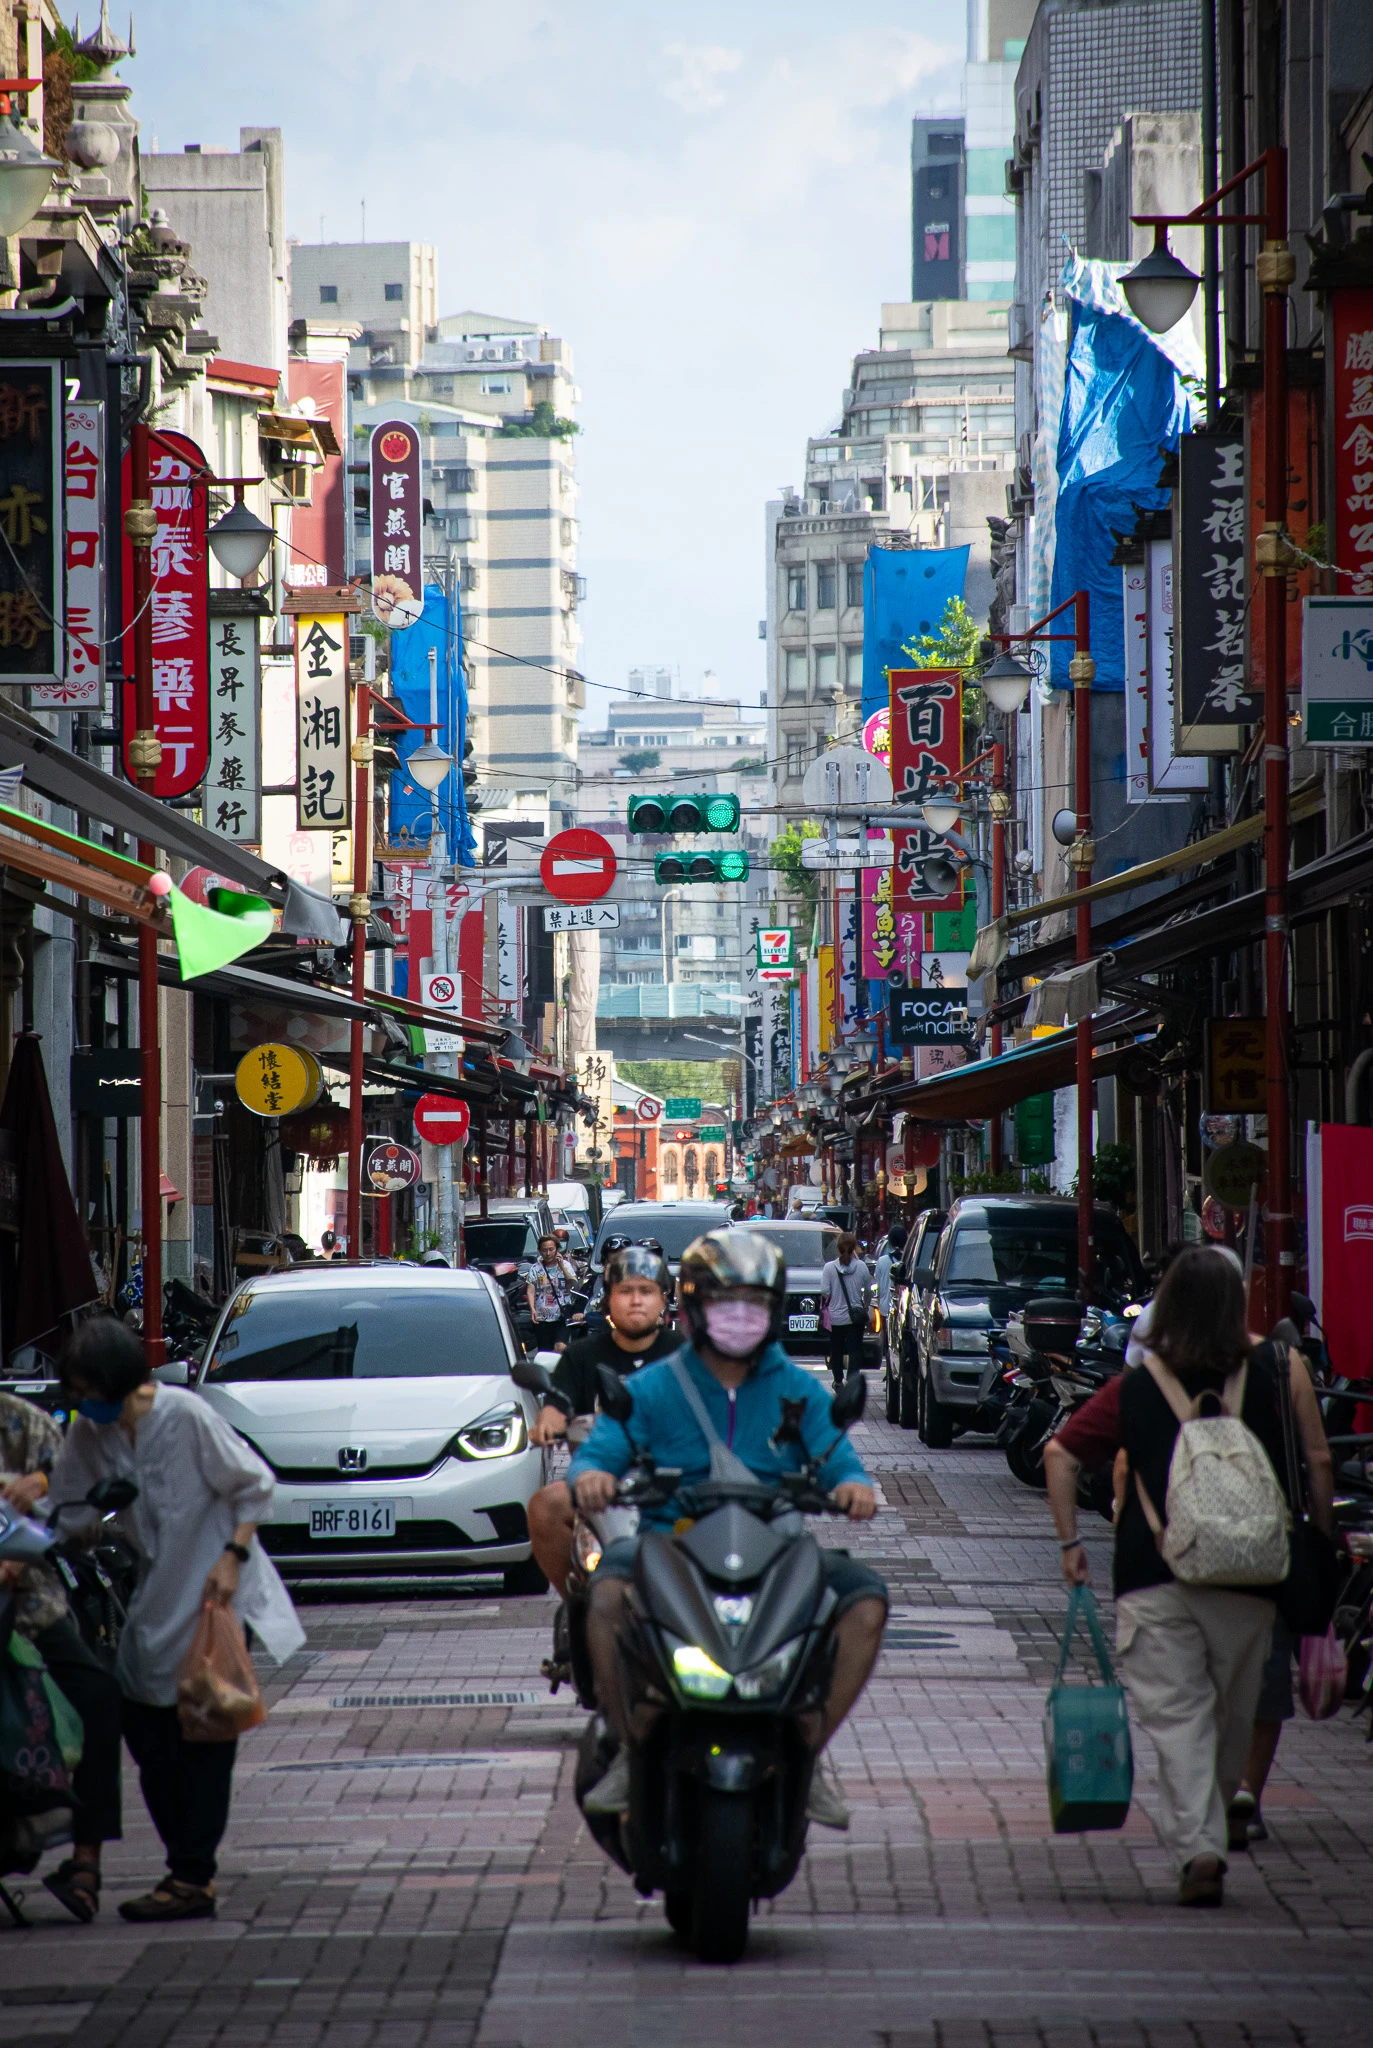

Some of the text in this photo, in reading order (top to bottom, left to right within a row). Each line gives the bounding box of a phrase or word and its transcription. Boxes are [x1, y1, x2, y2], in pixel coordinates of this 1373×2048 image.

[382, 471, 411, 575] 官燕閣
[300, 620, 345, 822] 金湘記
[550, 908, 616, 928] 禁止進入
[258, 1049, 284, 1111] 懷結堂
